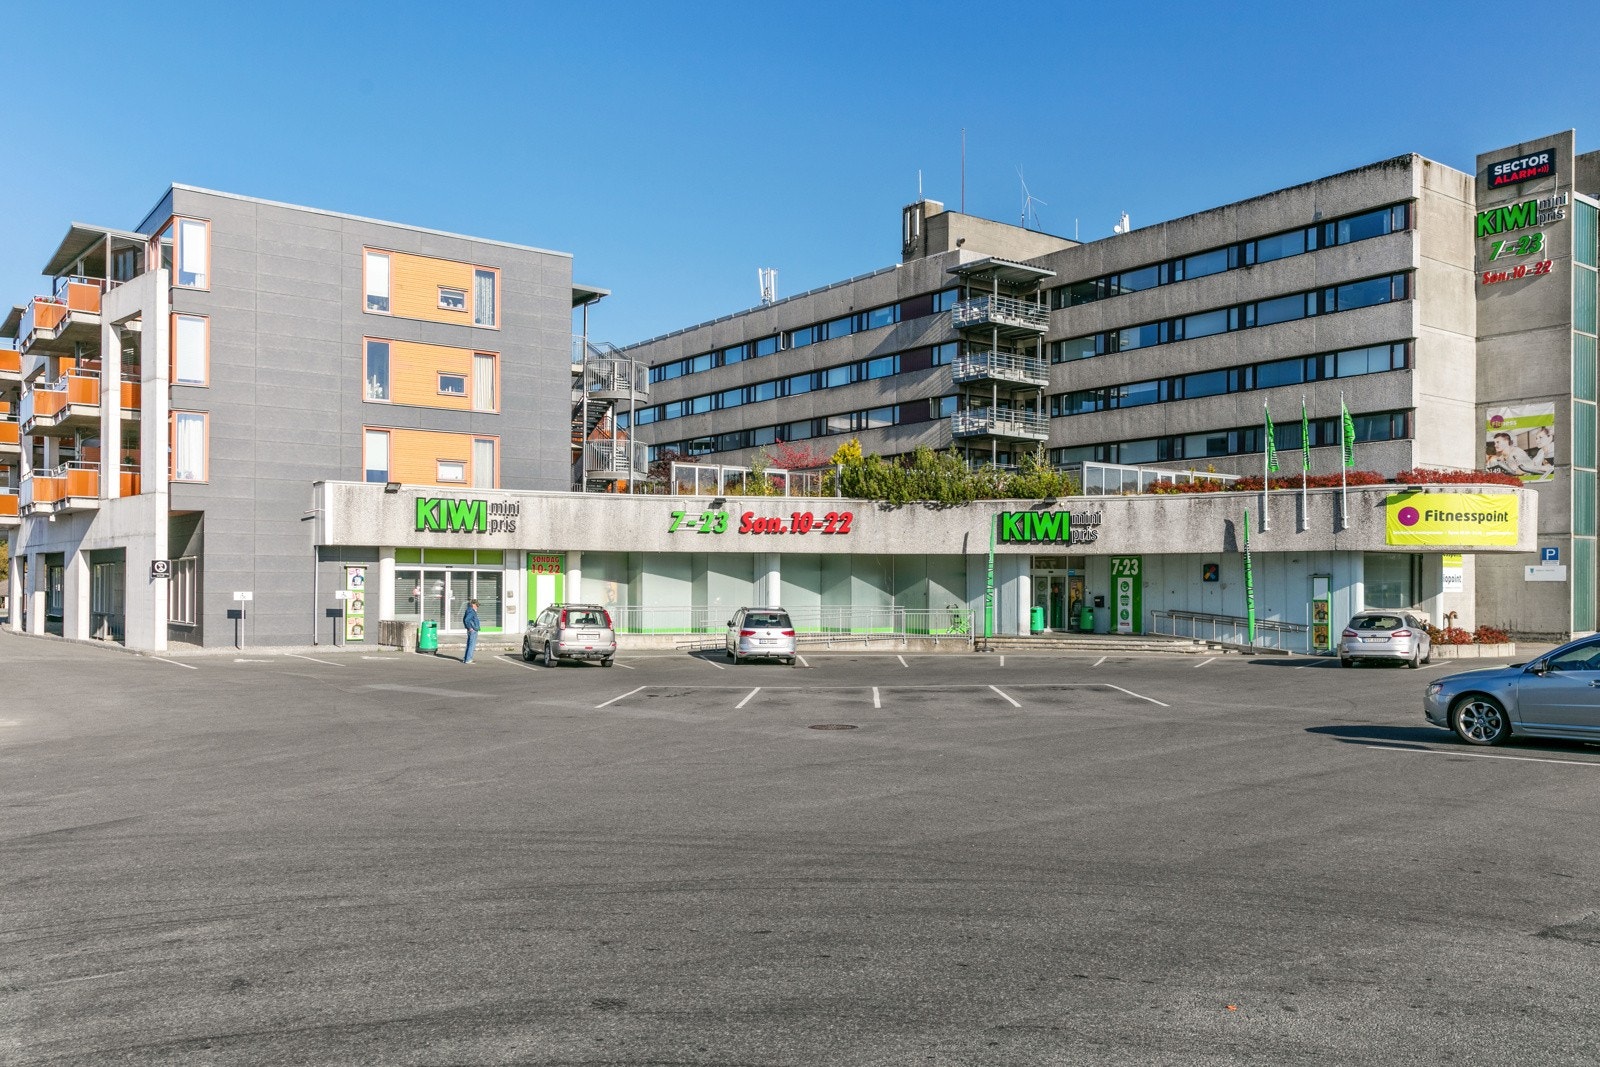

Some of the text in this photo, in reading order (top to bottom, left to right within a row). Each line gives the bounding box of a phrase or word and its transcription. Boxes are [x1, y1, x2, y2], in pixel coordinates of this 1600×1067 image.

[1494, 153, 1548, 176] SECTOR
[1494, 169, 1537, 185] ALARM
[1539, 192, 1568, 209] mini
[1477, 199, 1538, 238] KIWI
[1539, 209, 1565, 226] pris
[1512, 260, 1553, 279] 10-22
[415, 497, 488, 532] KIWI
[490, 500, 520, 515] mini
[490, 516, 517, 534] pris
[668, 511, 730, 534] 7-23
[738, 511, 854, 534] Søn. 10-22
[1071, 510, 1102, 525] mini
[1425, 509, 1508, 524] Fitnesspoint
[1002, 511, 1071, 542] KIWI
[1071, 526, 1099, 543] pris
[1546, 549, 1556, 560] P
[531, 564, 561, 573] 10-22
[1112, 559, 1139, 575] 7-23
